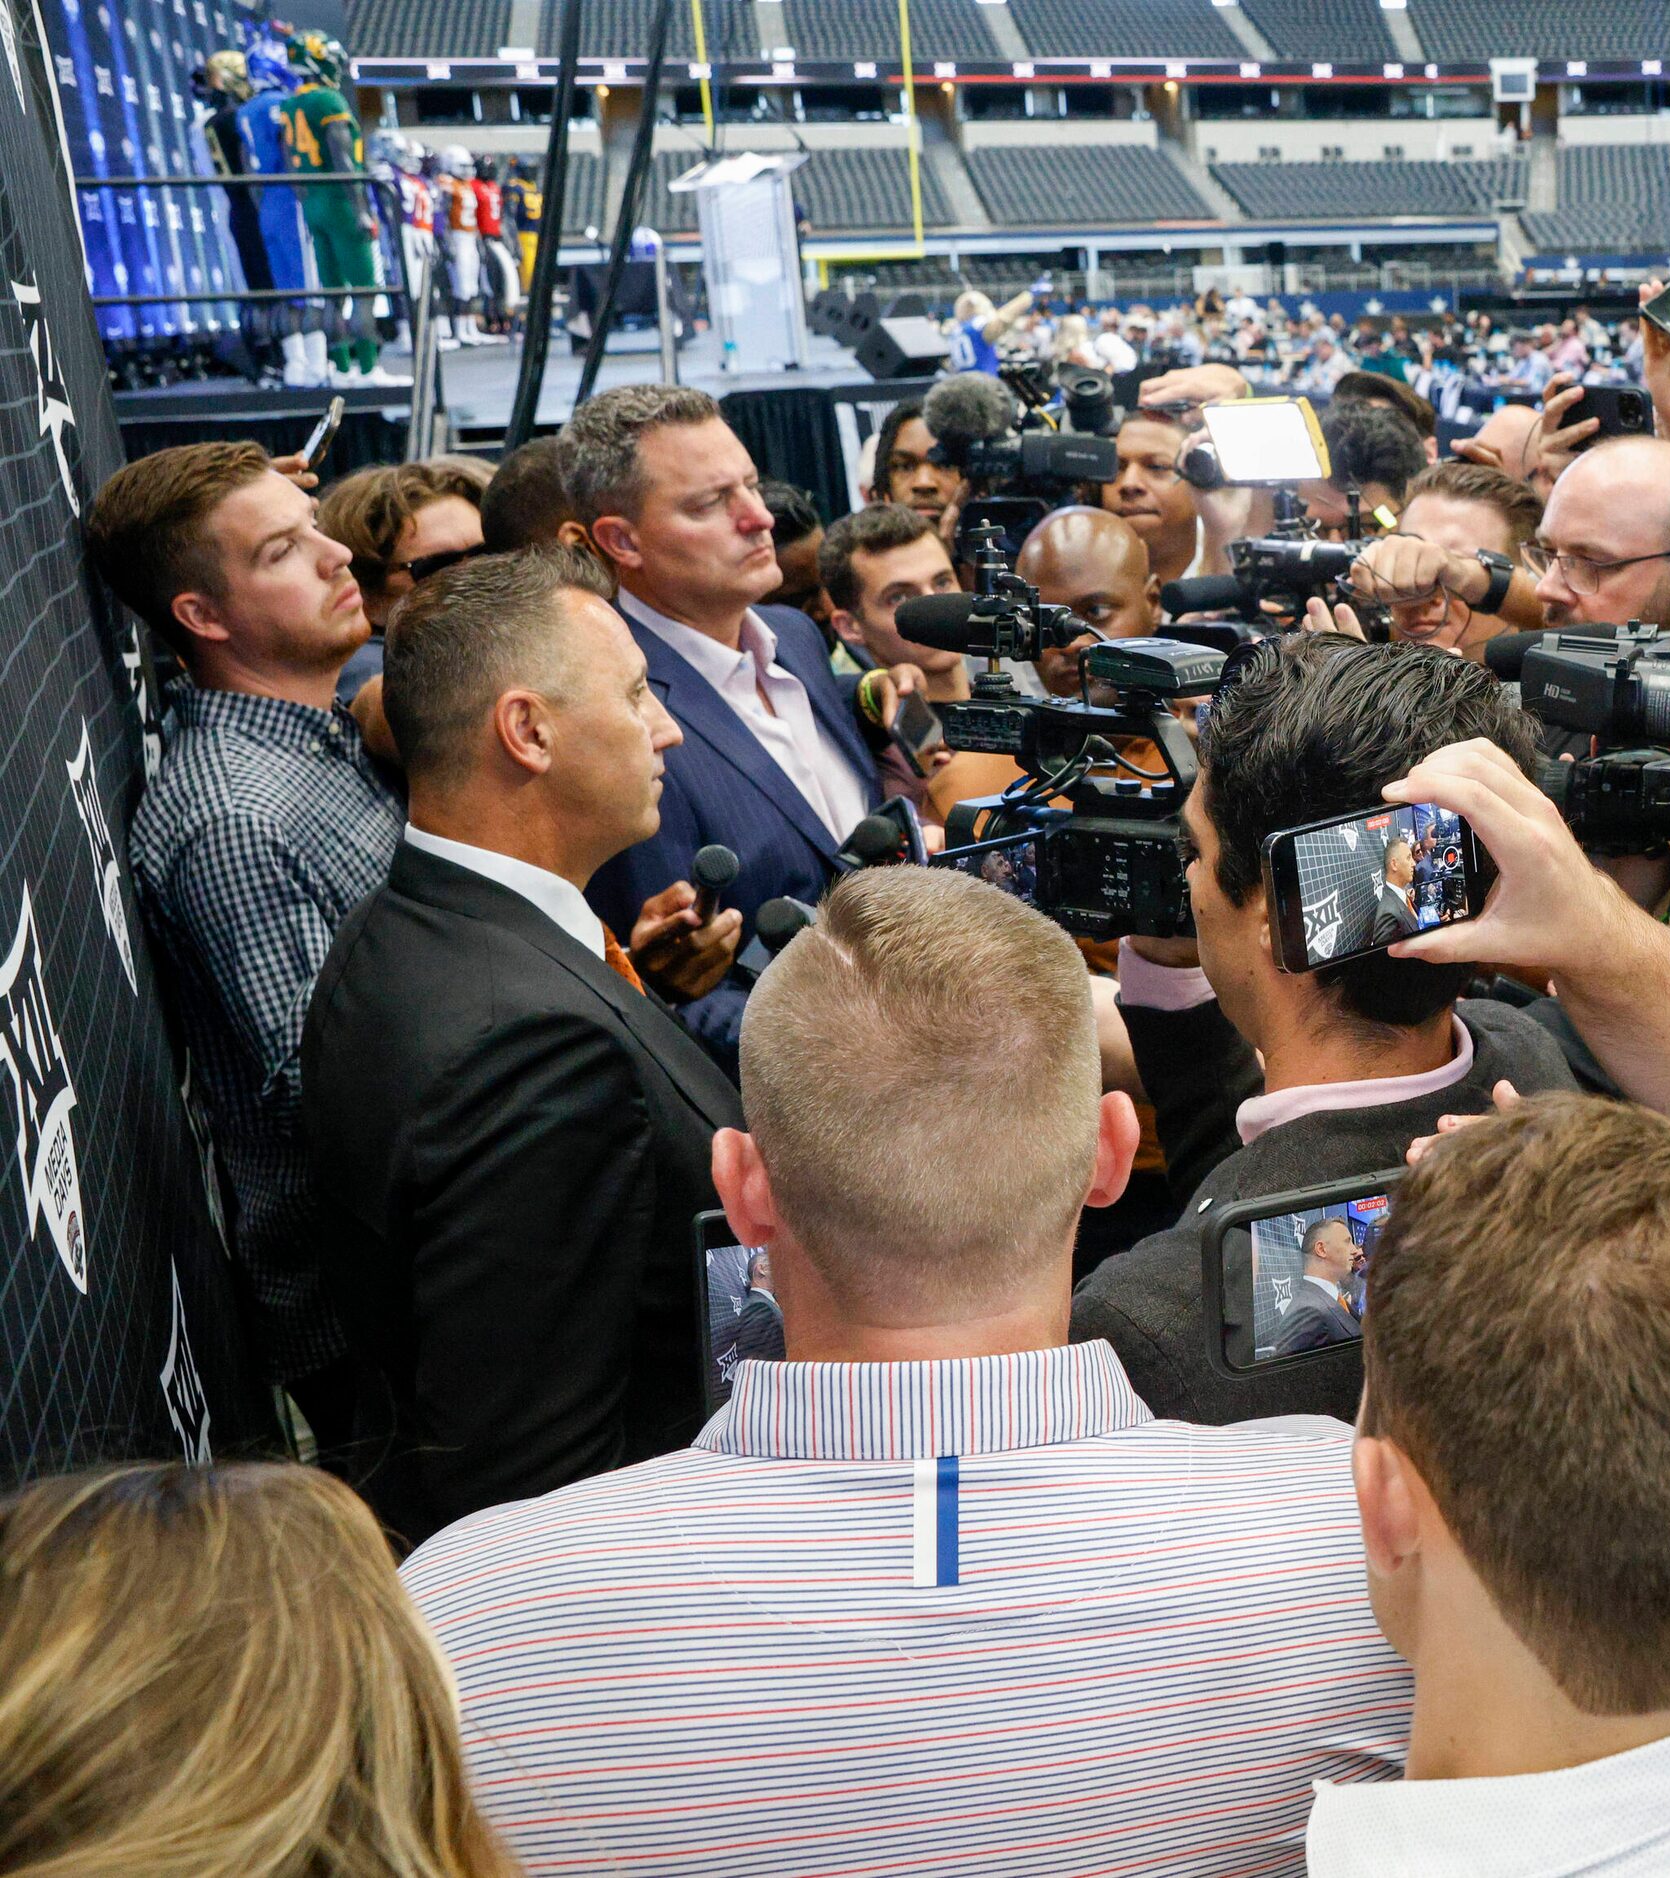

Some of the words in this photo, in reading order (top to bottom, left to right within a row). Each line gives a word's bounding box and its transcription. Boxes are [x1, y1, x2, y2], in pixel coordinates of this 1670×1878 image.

[1543, 683, 1560, 699] HD
[44, 1119, 69, 1191] MEDIA
[54, 1158, 73, 1221] DAYS
[1357, 1200, 1385, 1211] 00:02:02
